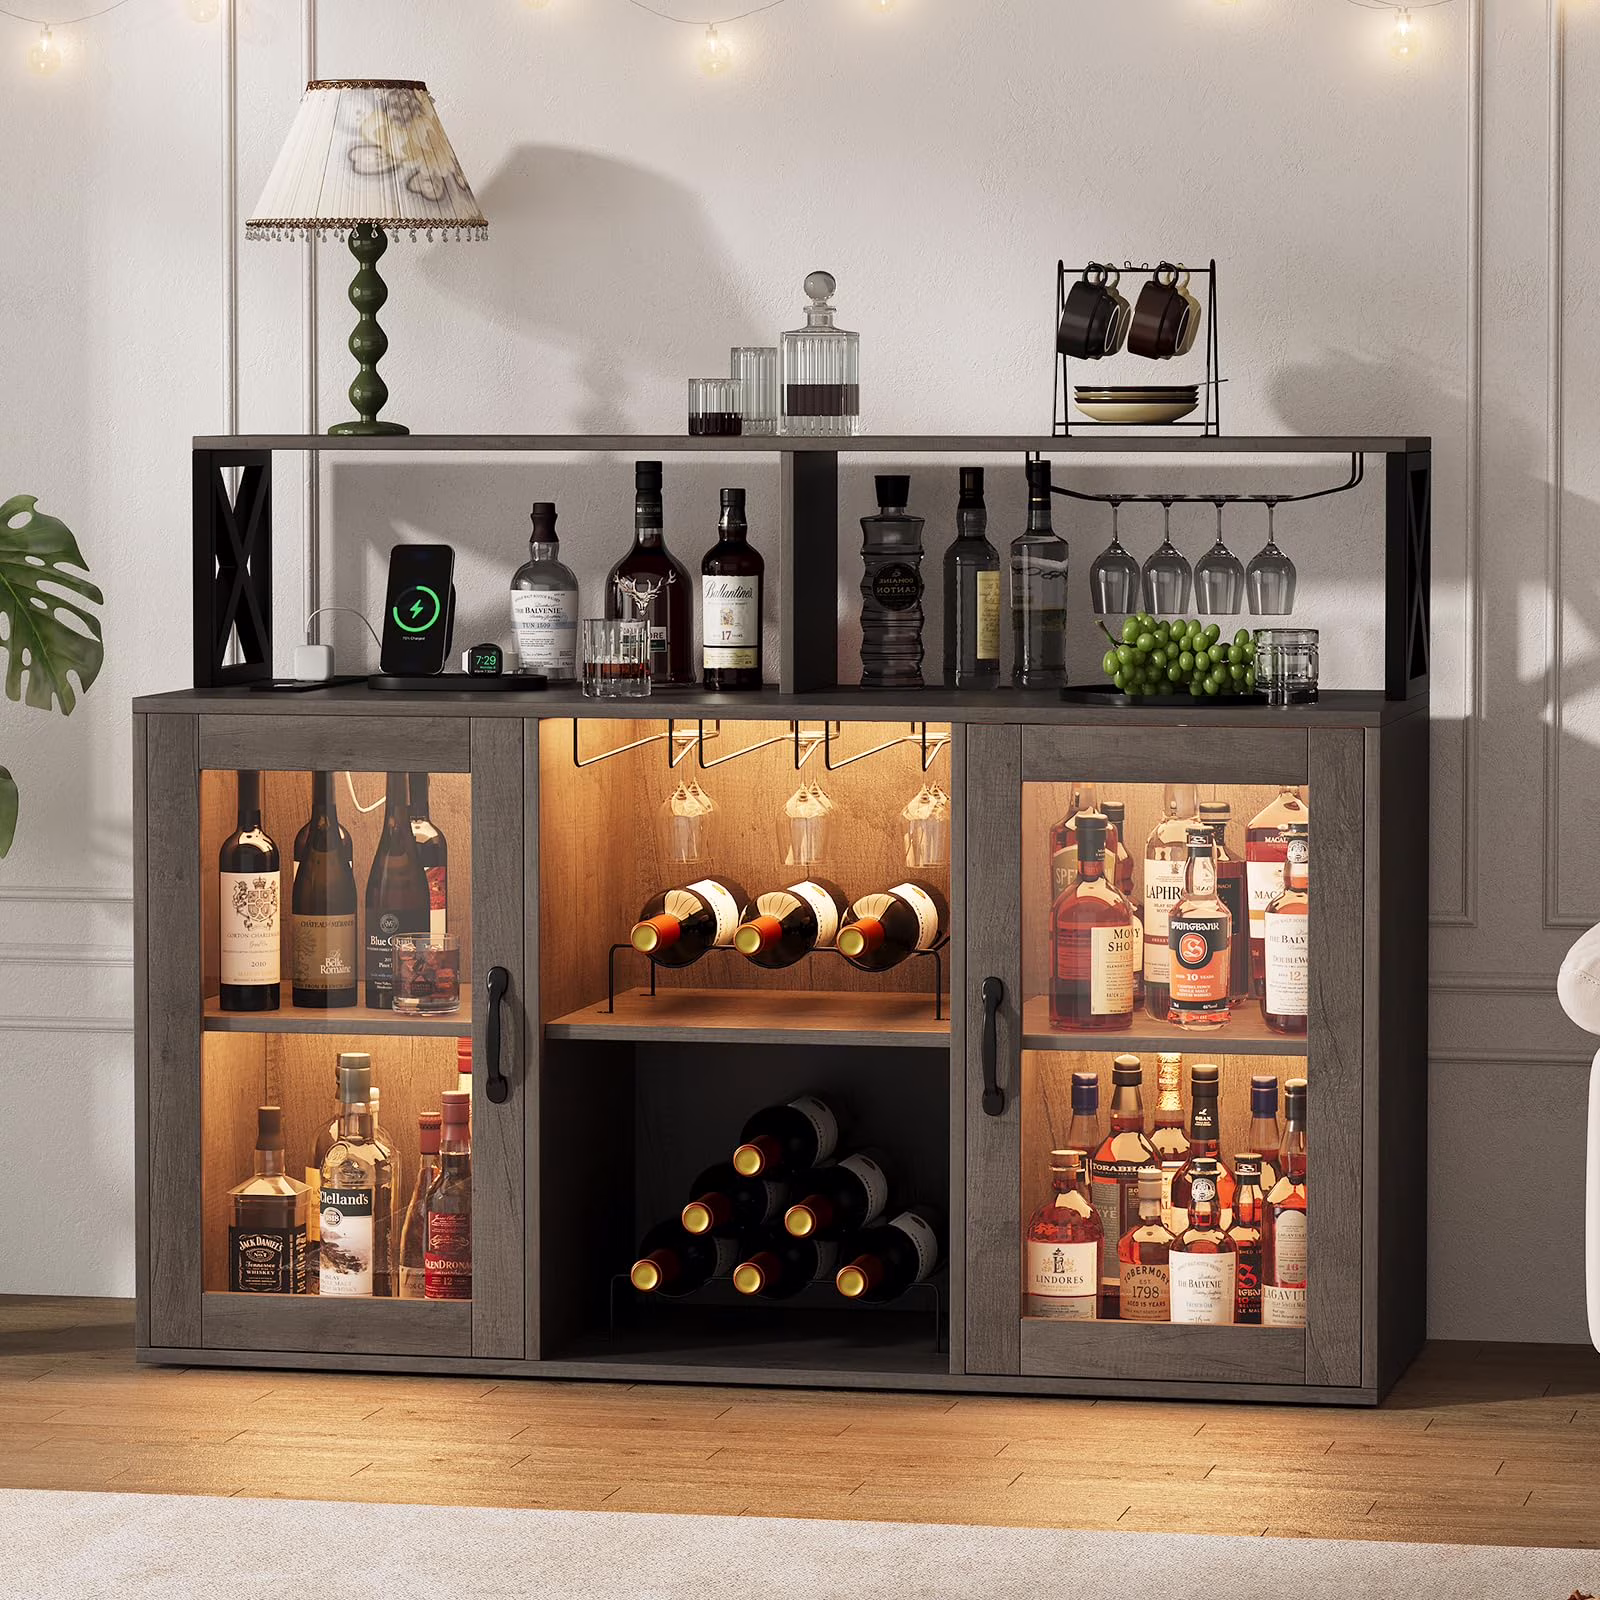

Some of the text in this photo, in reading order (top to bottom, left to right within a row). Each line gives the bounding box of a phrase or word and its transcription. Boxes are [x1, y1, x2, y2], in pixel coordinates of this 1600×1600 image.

[721, 630, 732, 640] 17
[475, 655, 496, 665] 7:29
[1264, 836, 1288, 844] MACAL
[1254, 890, 1278, 899] MAC
[370, 935, 387, 946] Blue
[1281, 934, 1306, 944] BALV
[1108, 941, 1134, 952] SHO
[325, 957, 344, 967] Belle
[320, 964, 351, 974] Romaine
[1186, 973, 1199, 981] 10
[1289, 971, 1301, 981] 12
[239, 1236, 284, 1252] JACK DANIEL'S
[1035, 1275, 1084, 1284] LINDORES
[1124, 1265, 1169, 1286] TOBERMORY
[443, 1276, 453, 1286] 12
[1188, 1279, 1223, 1289] BALVENIE
[1132, 1286, 1160, 1299] 1798
[1263, 1287, 1306, 1301] LAGAVUL
